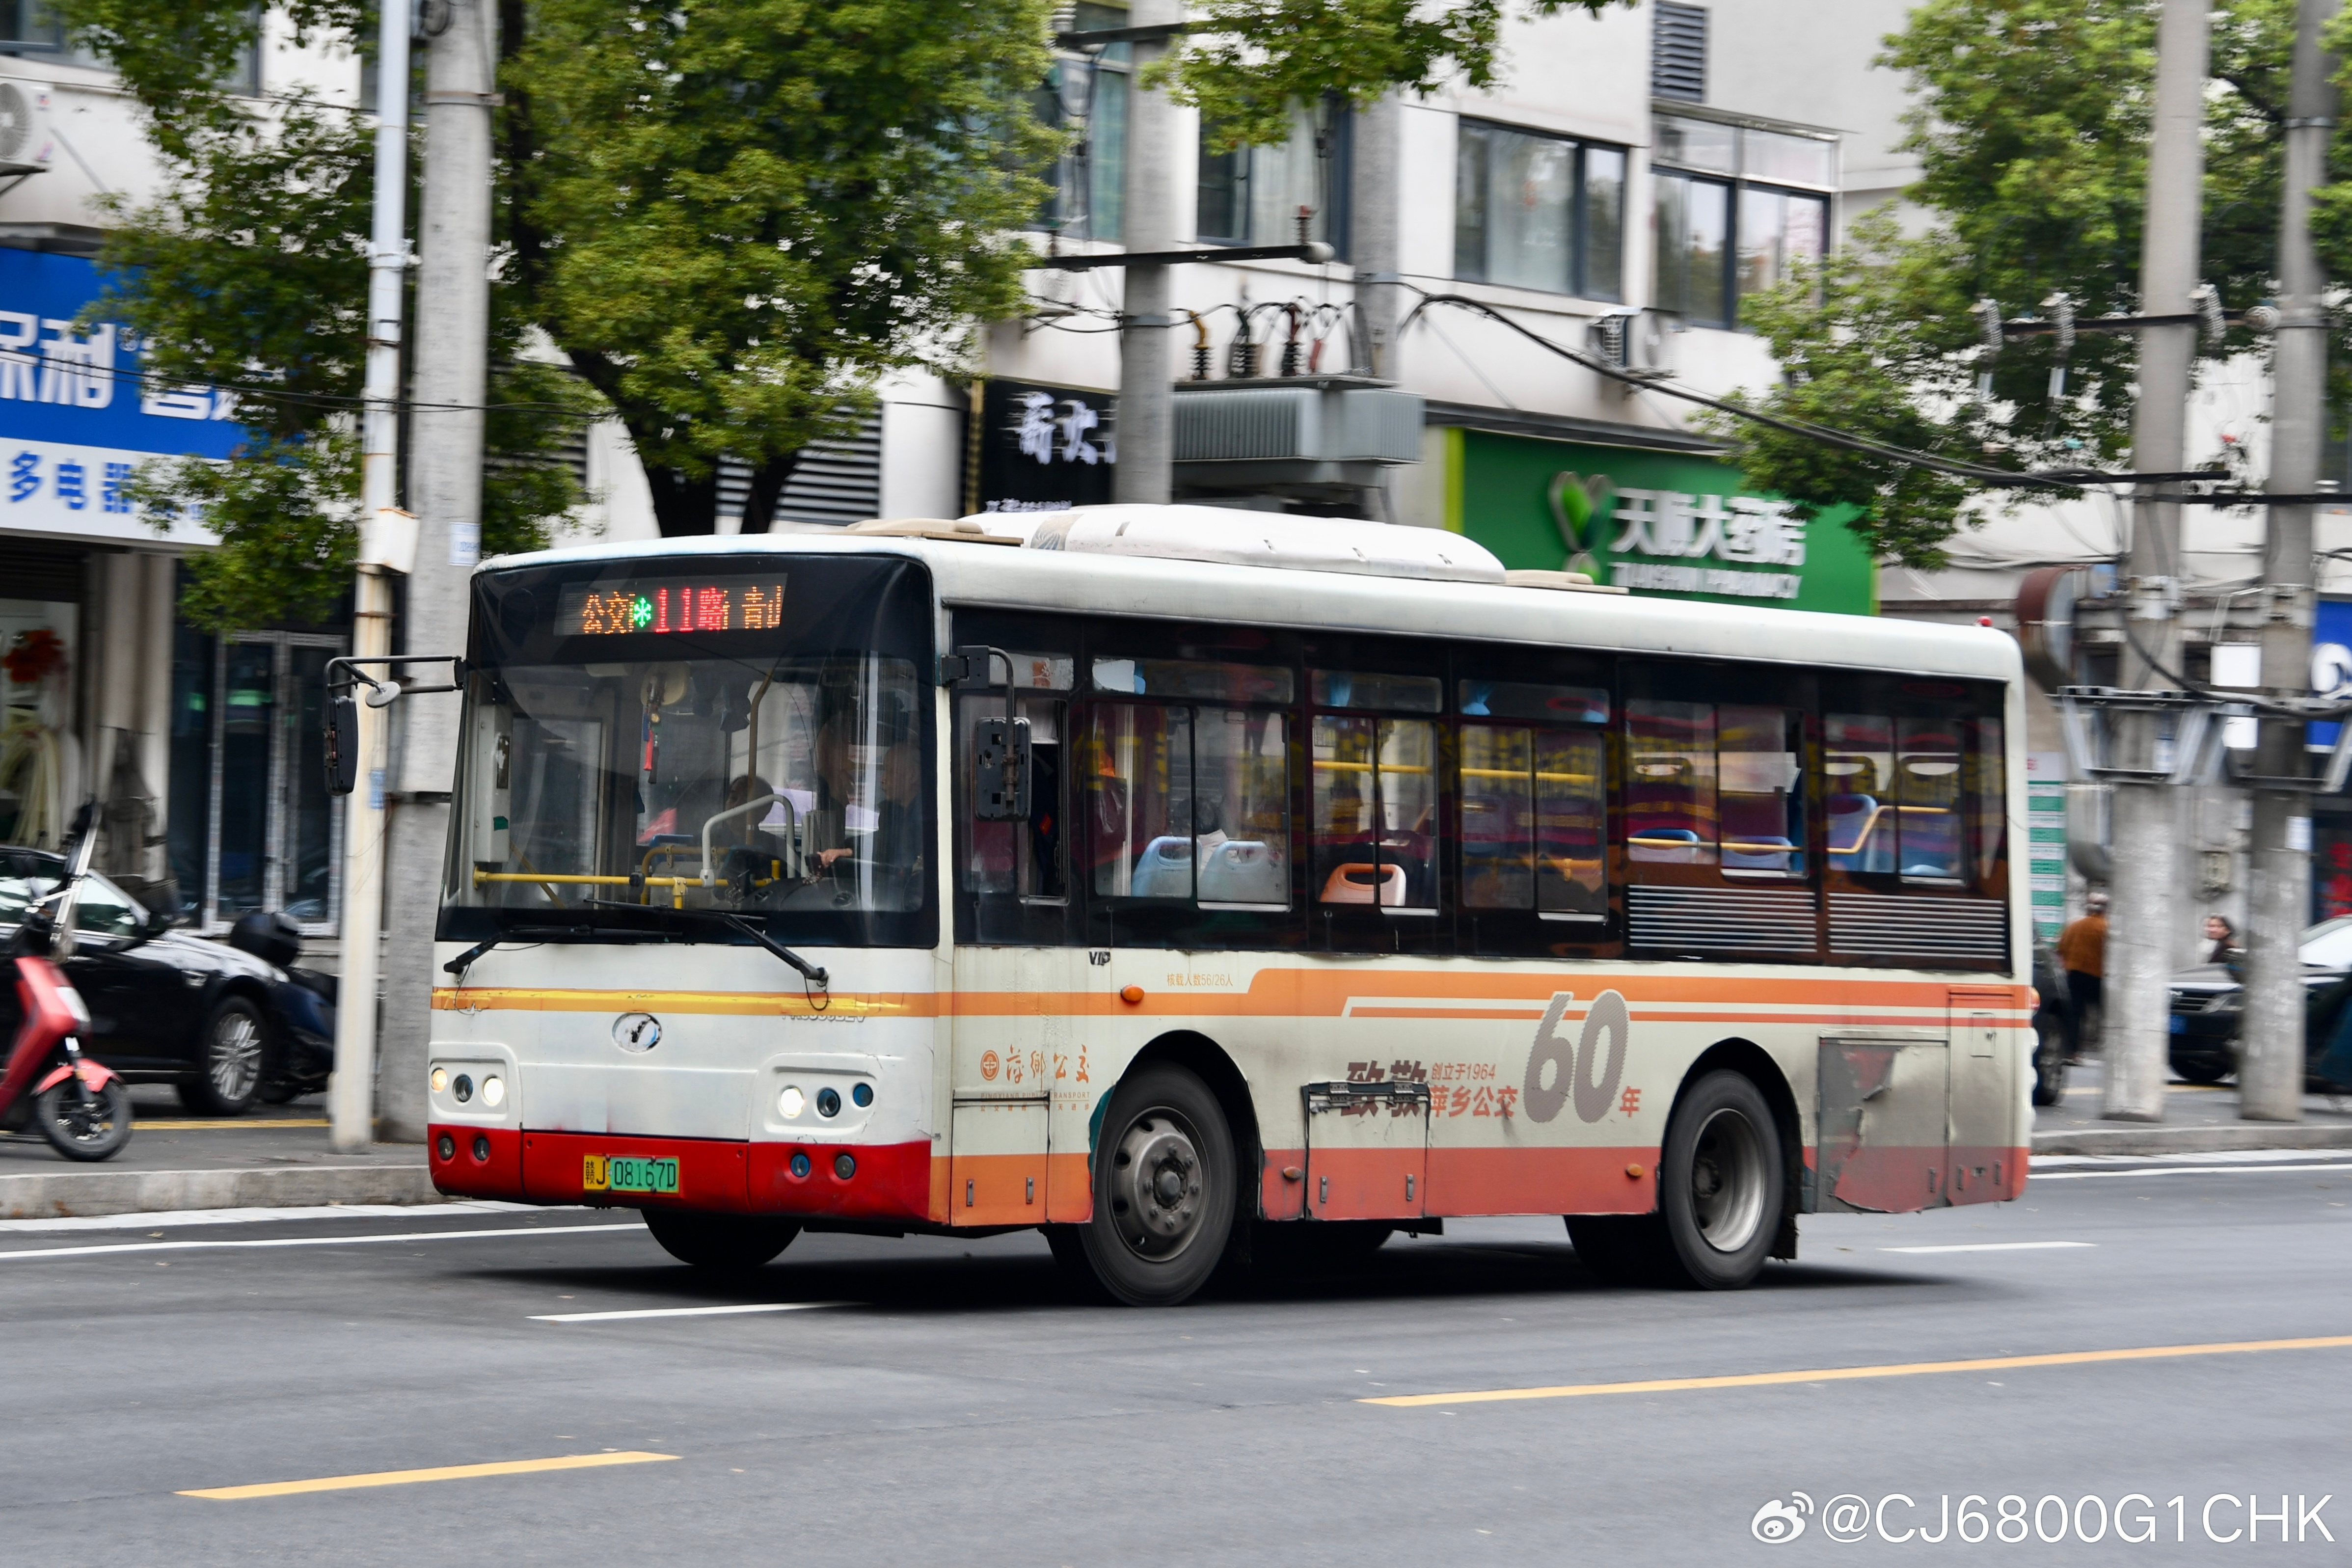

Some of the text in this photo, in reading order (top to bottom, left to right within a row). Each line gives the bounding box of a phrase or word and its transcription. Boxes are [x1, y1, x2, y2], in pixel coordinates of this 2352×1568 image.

[655, 587, 724, 634] 11路
[1167, 973, 1233, 986] 核载人数56/26人
[1425, 1084, 1518, 1118] 萍乡公交
[1523, 988, 1630, 1123] 60
[1619, 1086, 1641, 1118] 年
[1432, 1062, 1496, 1081] 创立于1964
